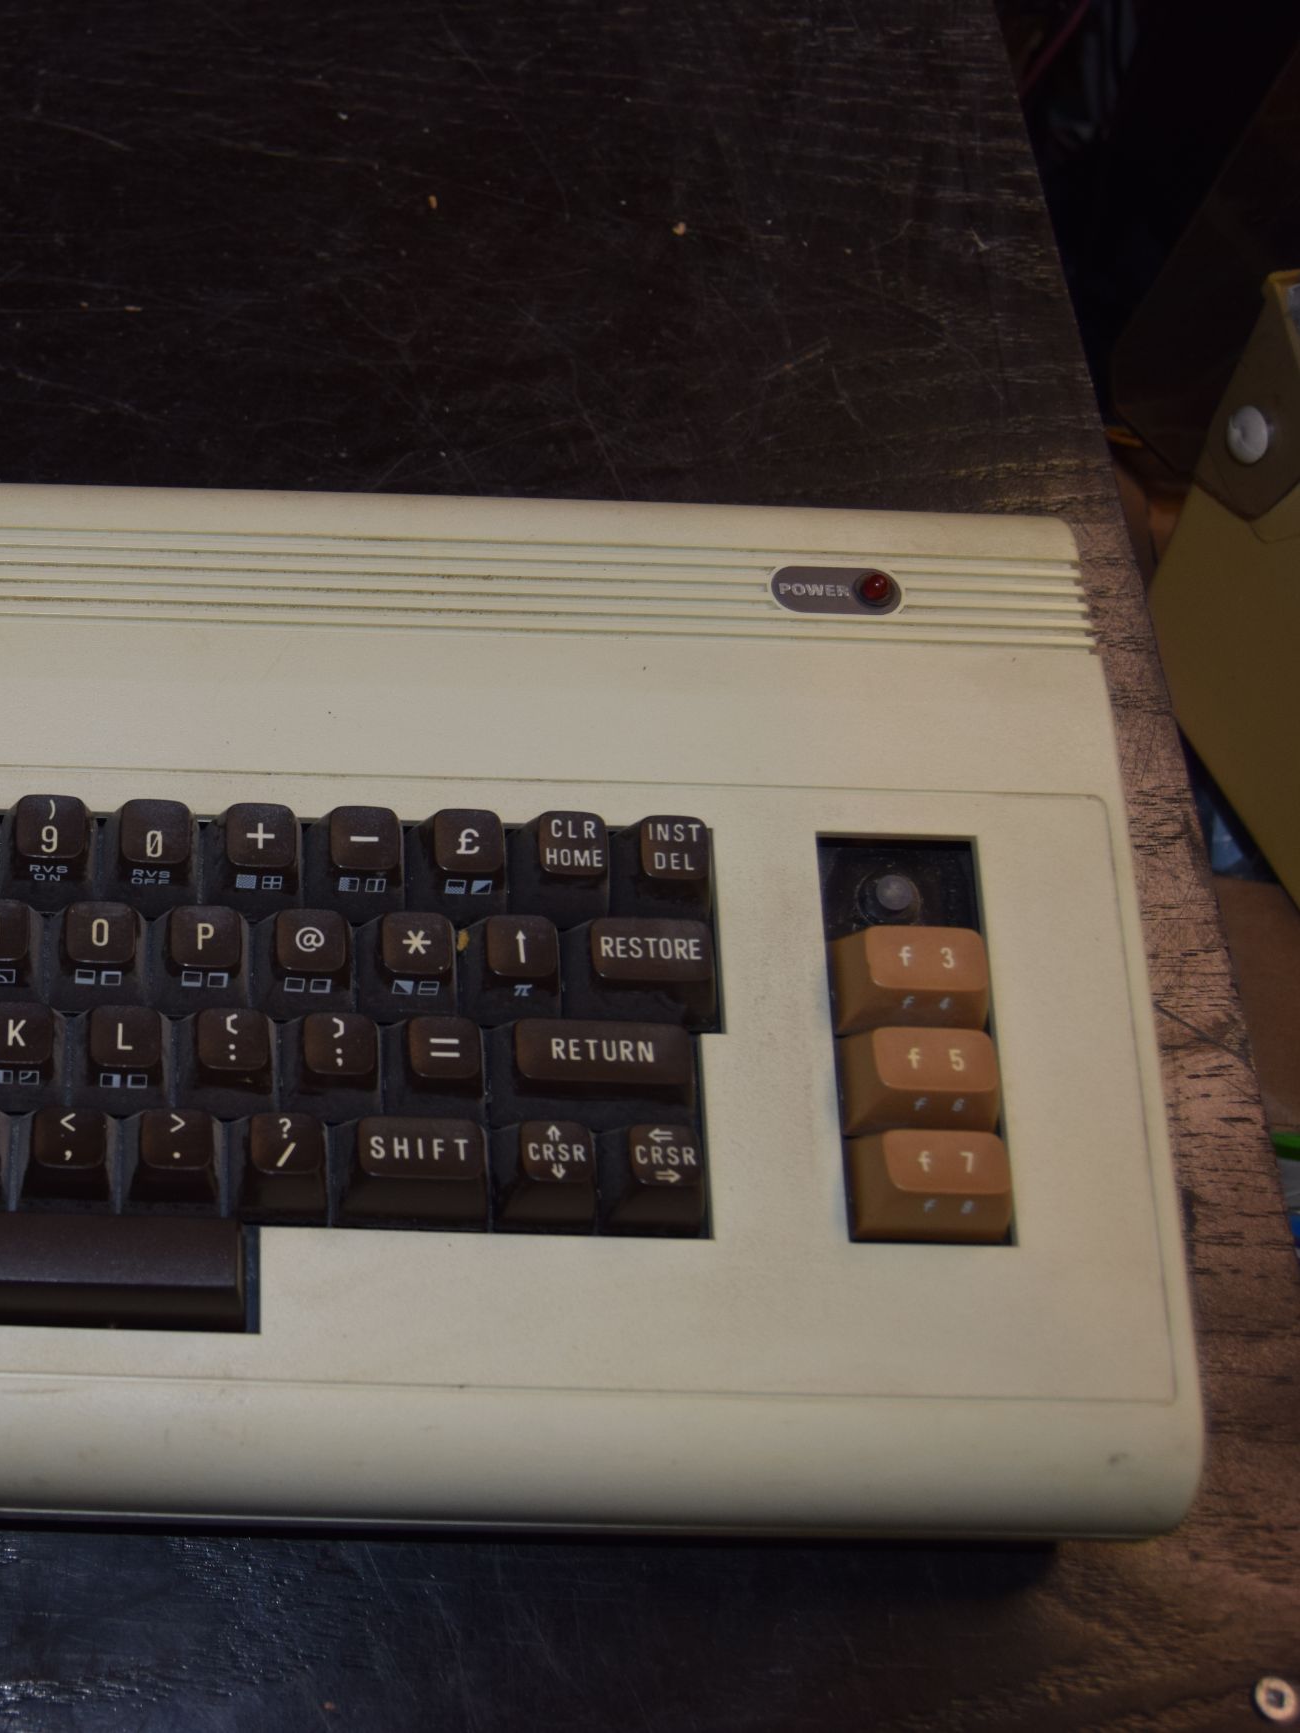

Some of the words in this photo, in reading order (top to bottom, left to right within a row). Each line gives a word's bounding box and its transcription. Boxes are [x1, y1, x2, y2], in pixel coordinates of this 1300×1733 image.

[779, 583, 850, 596] POWER
[41, 825, 58, 853] 9
[551, 819, 596, 838] CLR
[649, 823, 700, 842] INST
[456, 828, 480, 855] £
[546, 848, 602, 868] HOME
[654, 852, 694, 871] DEL
[29, 864, 68, 875] RVS
[34, 873, 61, 882] ON
[132, 869, 170, 879] RVS
[131, 876, 170, 885] OFF
[92, 918, 109, 947] O
[197, 922, 214, 950] P
[295, 927, 325, 952] @
[600, 936, 702, 961] RESTORE
[7, 1018, 26, 1047] K
[117, 1022, 133, 1050] L
[551, 1038, 654, 1063] RETURN
[370, 1136, 469, 1161] SHIFT
[528, 1142, 586, 1162] CRSR
[635, 1146, 696, 1167] CRSR
